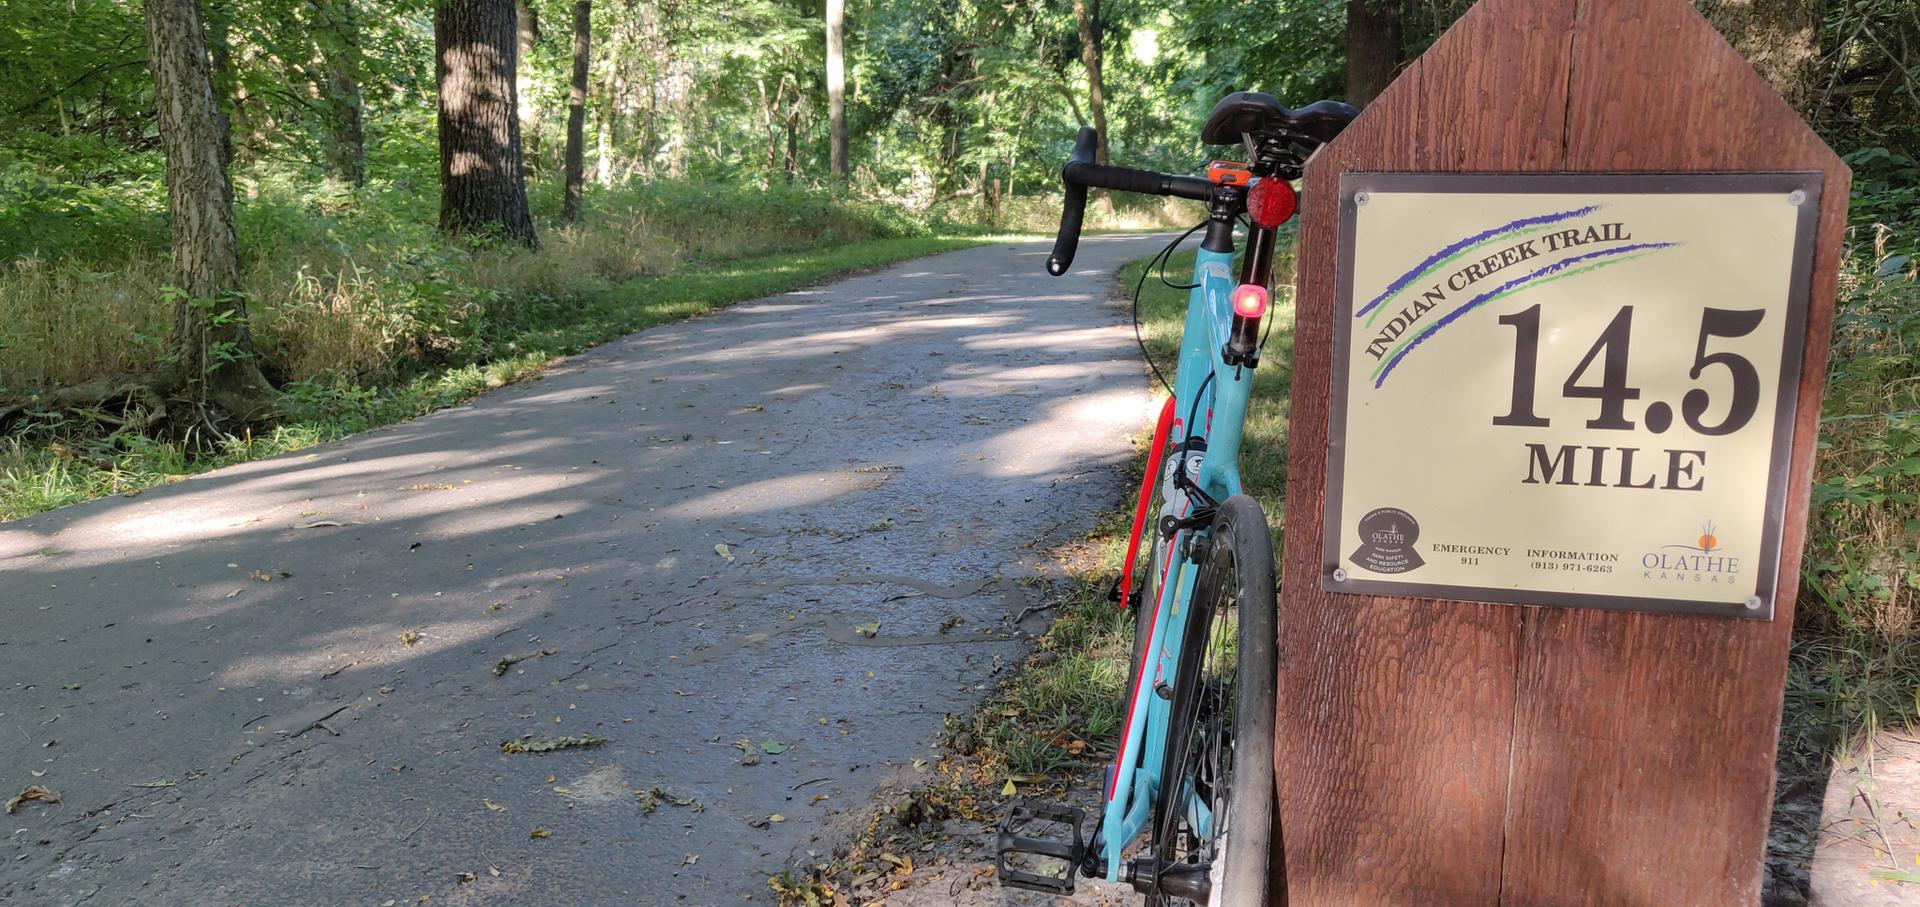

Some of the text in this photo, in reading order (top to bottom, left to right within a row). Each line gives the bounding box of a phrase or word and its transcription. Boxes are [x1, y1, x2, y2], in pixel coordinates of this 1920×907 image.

[1365, 222, 1632, 361] INDIAN CREEK TRAIL
[1492, 303, 1767, 437] 14.5
[1521, 442, 1707, 492] MILE
[1371, 532, 1404, 540] OLATHE
[1432, 543, 1511, 556] EMERGENCY
[1526, 549, 1619, 562] INFORMATION
[1366, 556, 1409, 567] AND RESOURCE
[1371, 552, 1385, 561] PARK
[1461, 556, 1480, 566] 911
[1642, 552, 1740, 574] OLATHE
[1369, 564, 1406, 572] EDUCATION
[1531, 560, 1613, 574] (913) 971-6263
[1643, 571, 1736, 584] KANSAS
